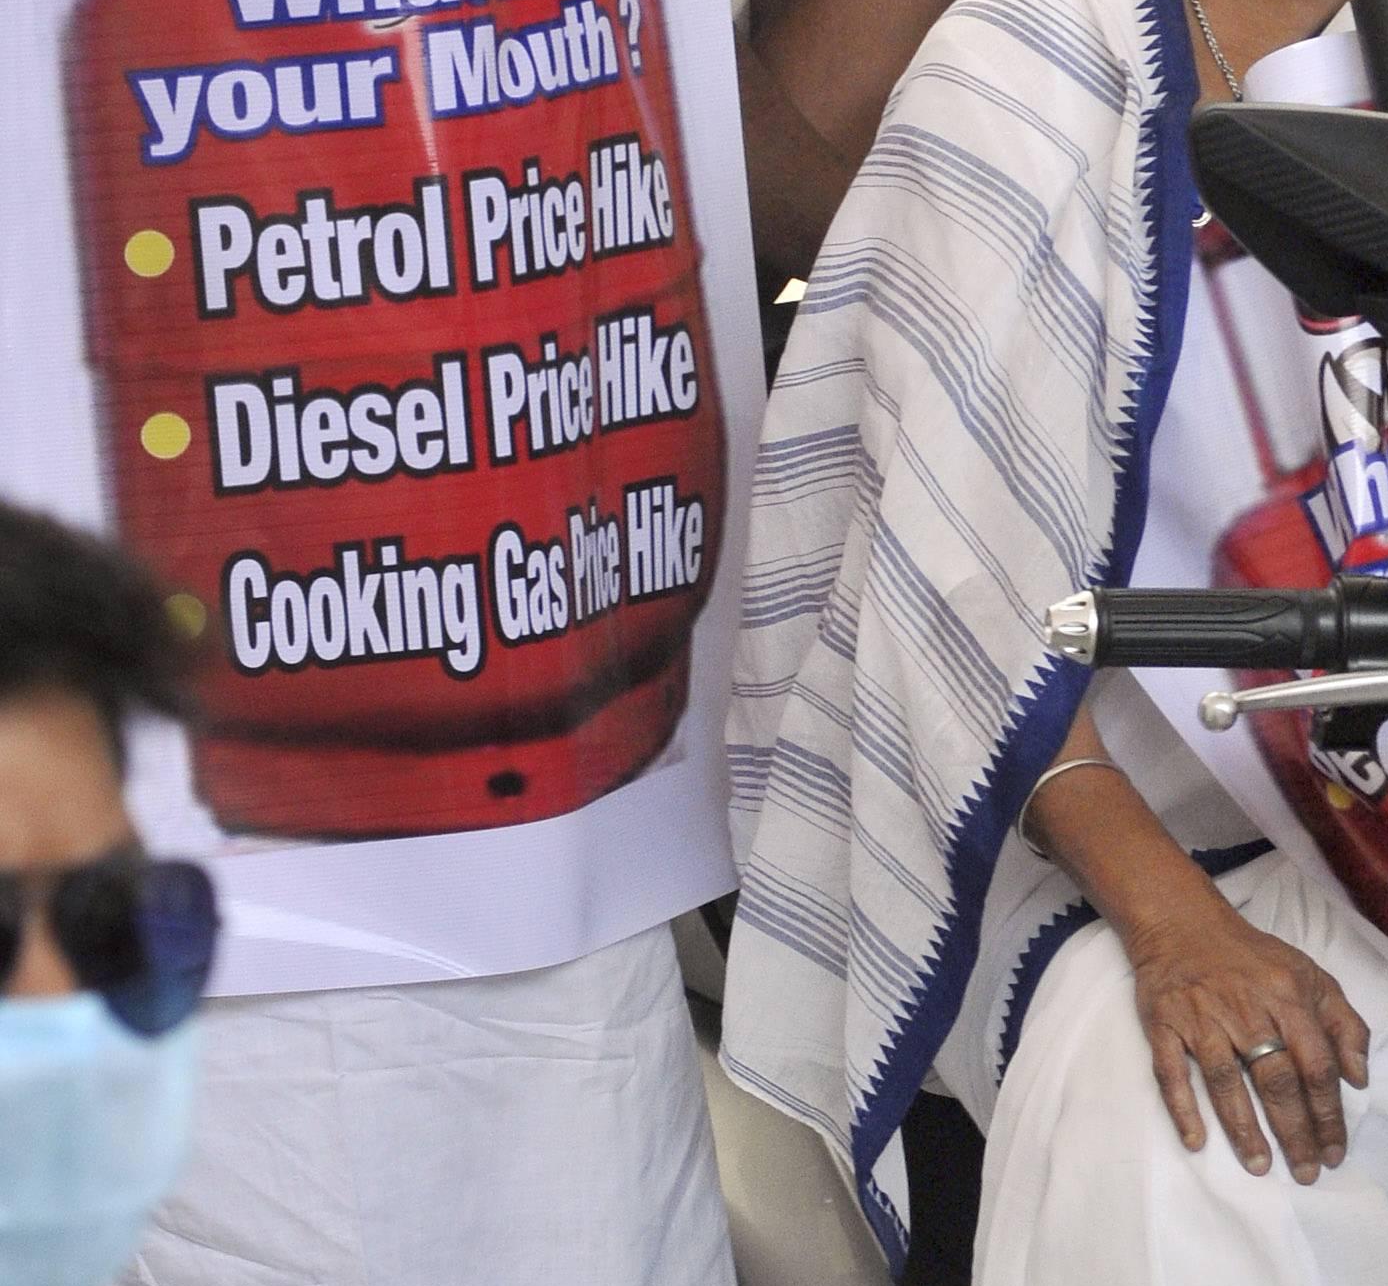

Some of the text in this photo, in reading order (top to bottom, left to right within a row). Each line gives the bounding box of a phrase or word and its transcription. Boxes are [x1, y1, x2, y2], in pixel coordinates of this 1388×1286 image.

[136, 54, 396, 159] your
[197, 139, 676, 312] Petrol Price Hike
[212, 313, 699, 489] Diesel Price Hike
[227, 482, 704, 675] Cooking Gas Price Hike
